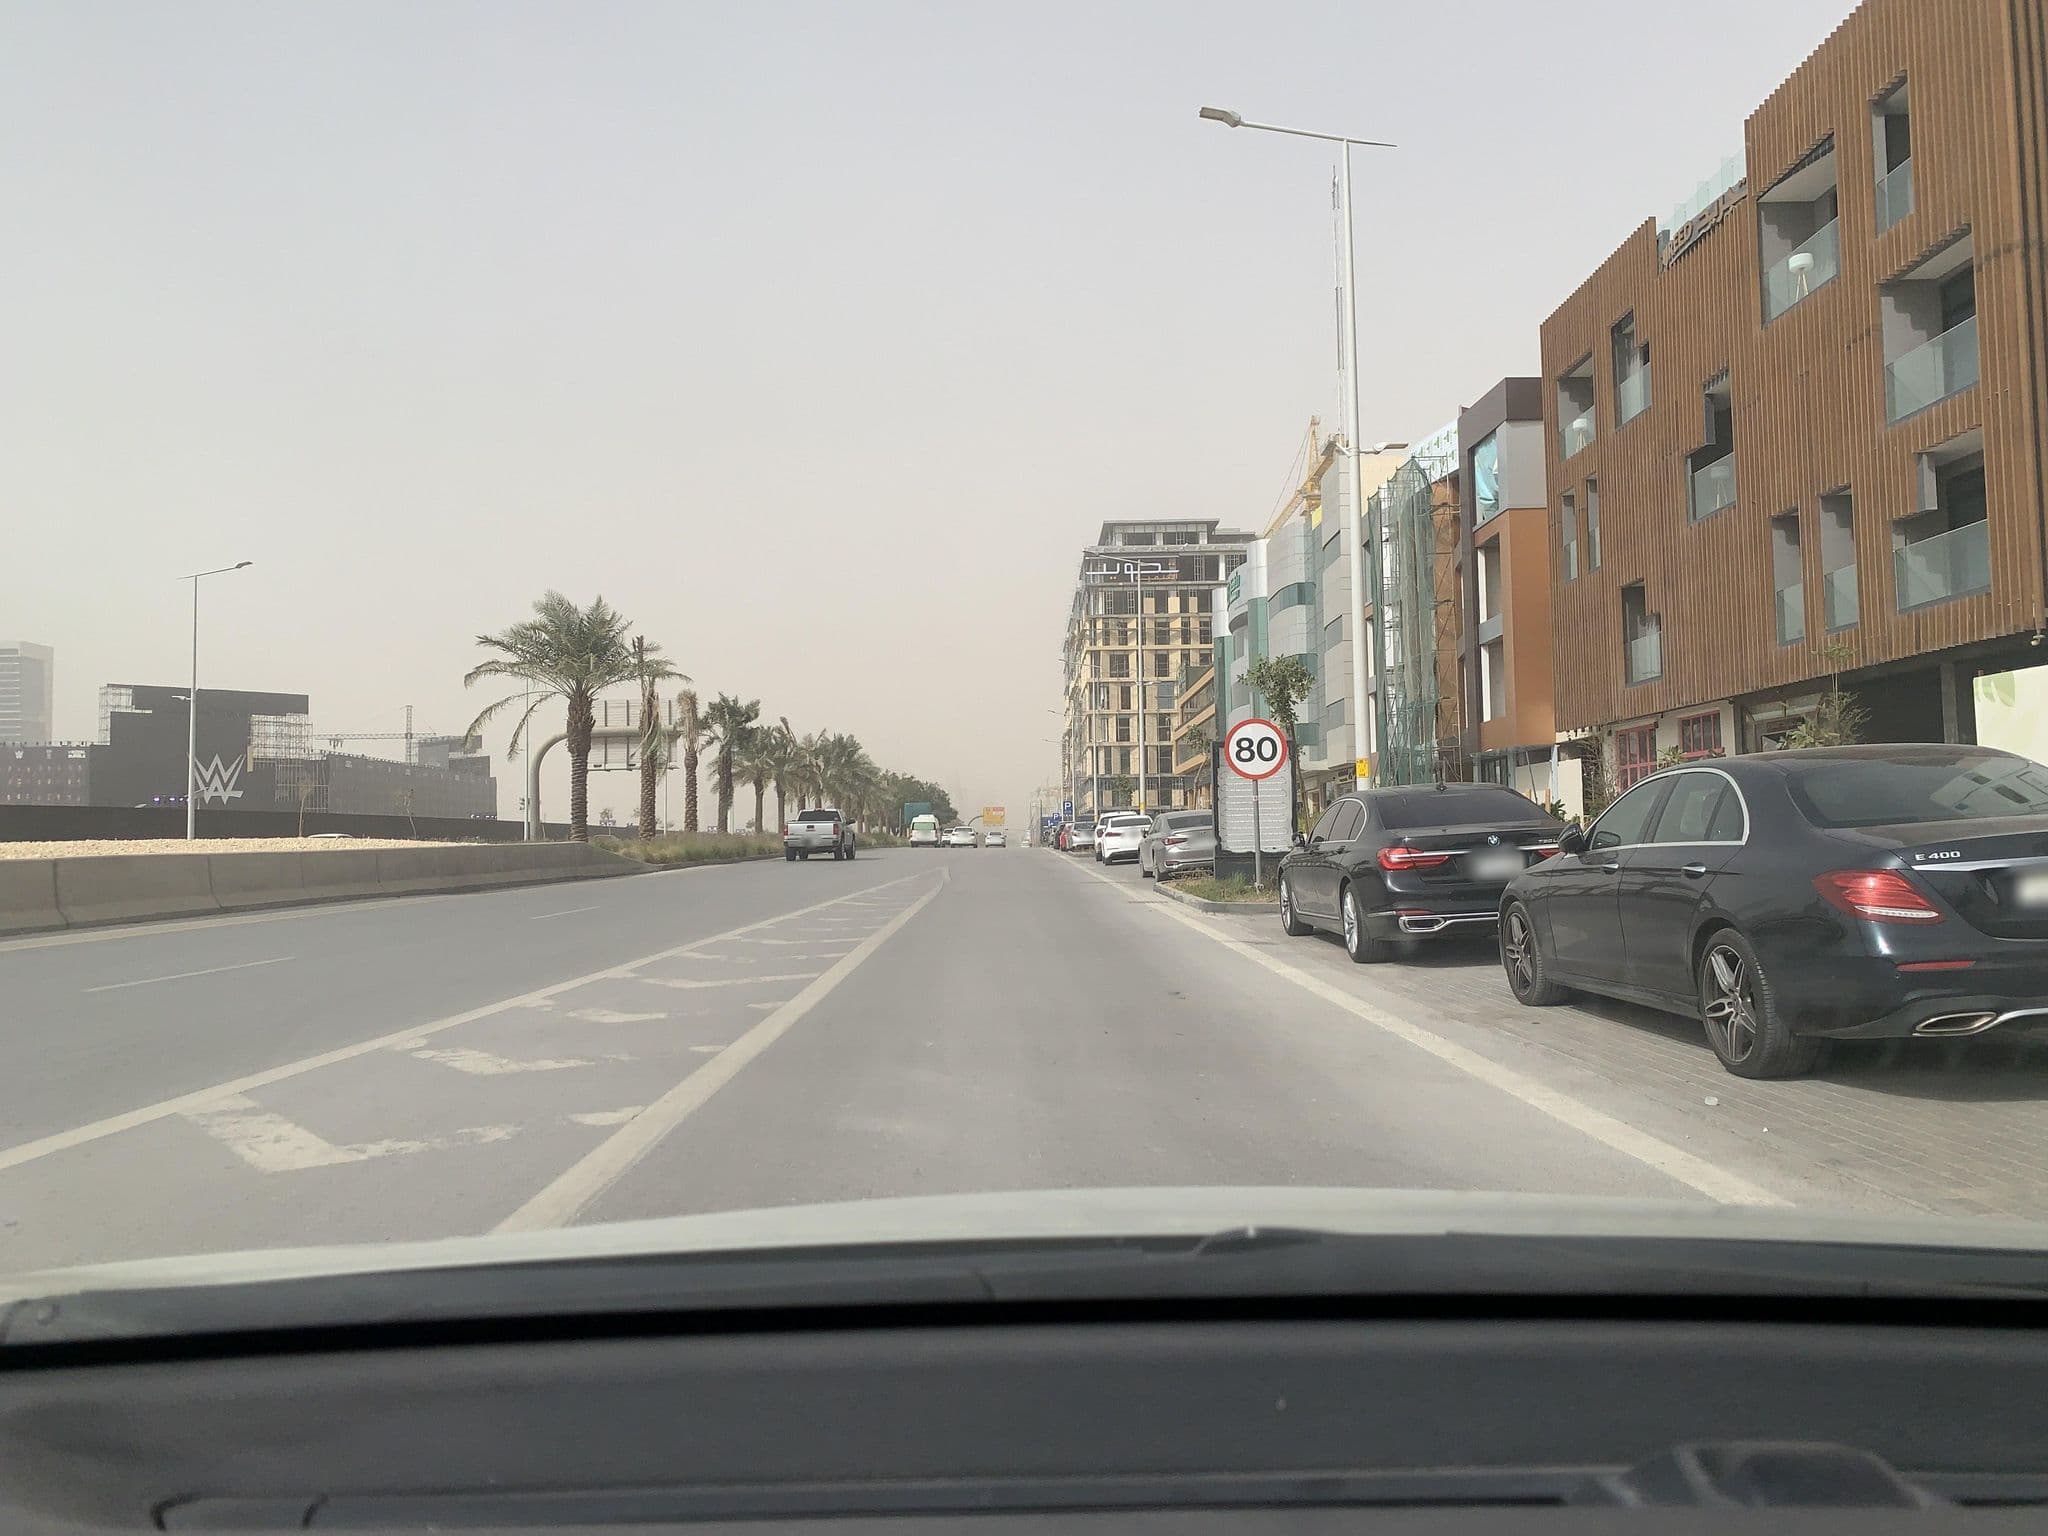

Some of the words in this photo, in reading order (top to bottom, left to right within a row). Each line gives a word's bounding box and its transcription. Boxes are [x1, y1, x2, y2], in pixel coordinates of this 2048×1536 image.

[1235, 736, 1277, 762] 80
[1915, 853, 1926, 861] E
[1928, 851, 1961, 859] 400
